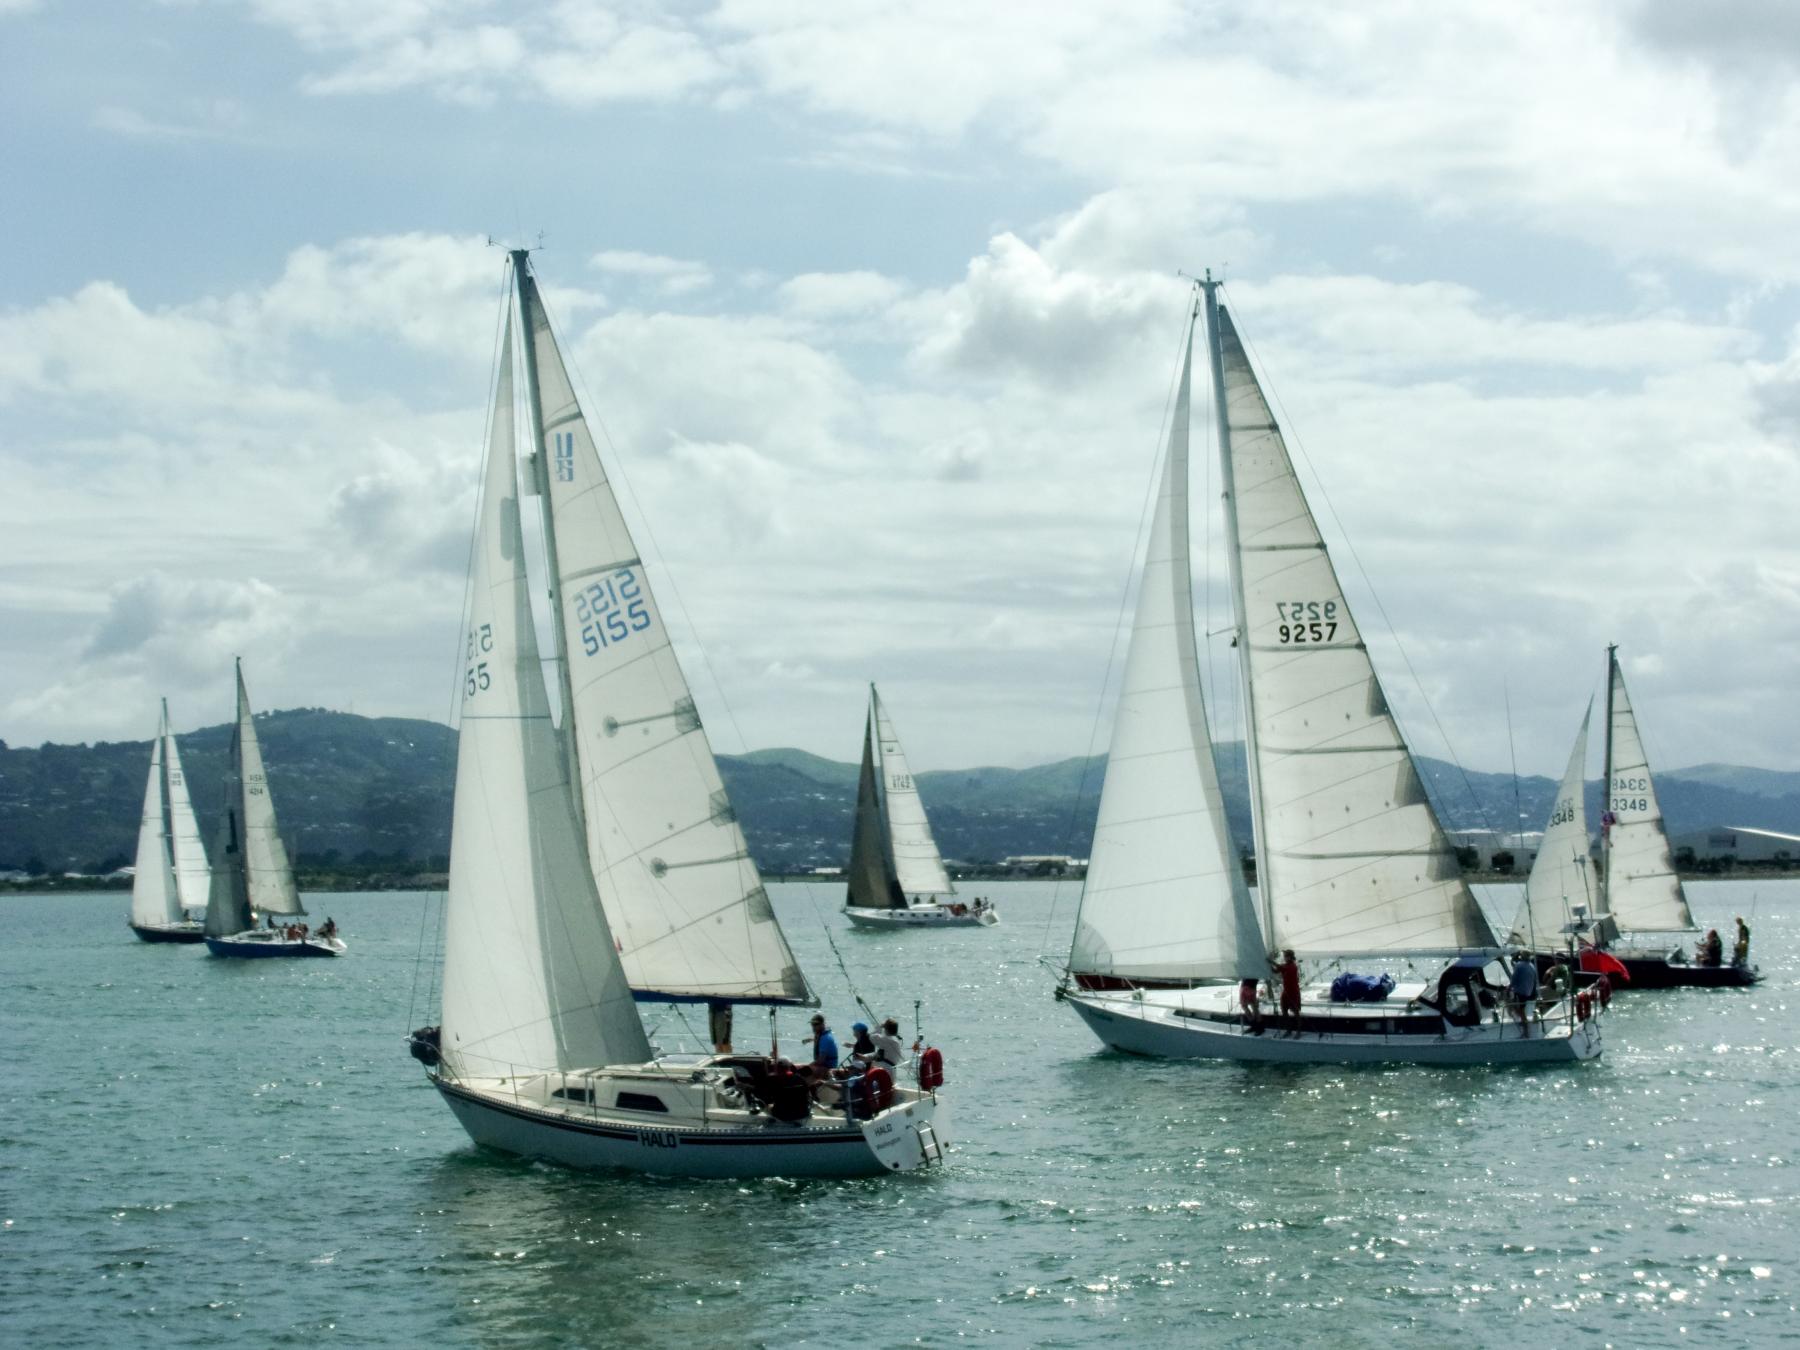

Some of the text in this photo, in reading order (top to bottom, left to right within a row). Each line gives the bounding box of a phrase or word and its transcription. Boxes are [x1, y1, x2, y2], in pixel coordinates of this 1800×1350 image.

[582, 598, 651, 657] 5155
[1279, 622, 1338, 643] 9257
[465, 662, 490, 698] 55
[1612, 798, 1647, 811] 3348
